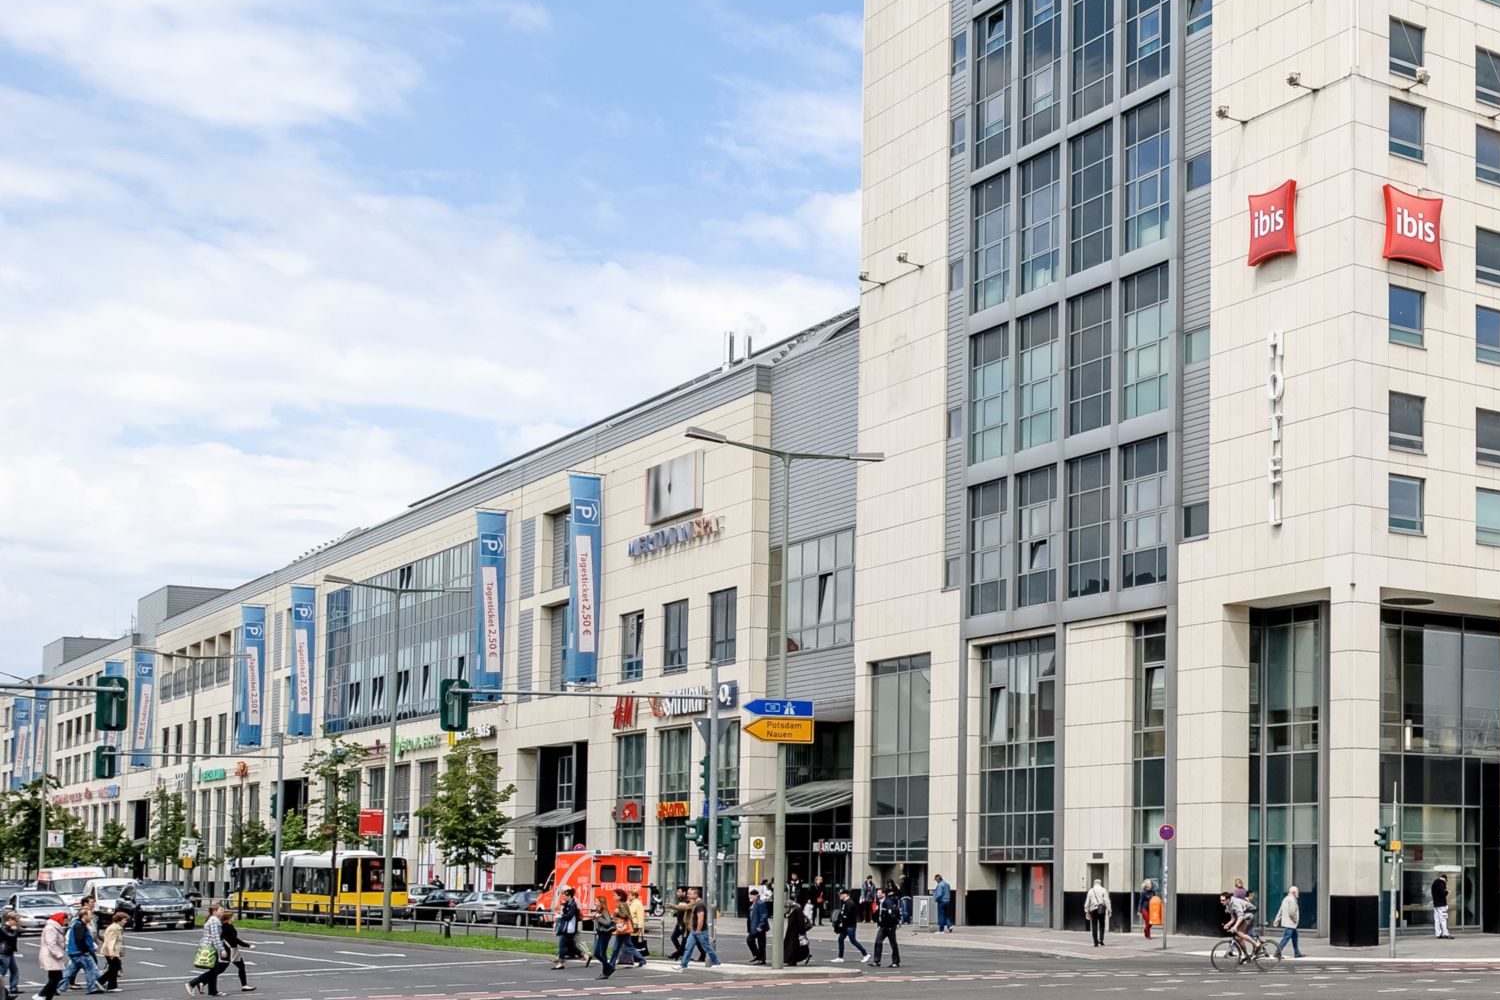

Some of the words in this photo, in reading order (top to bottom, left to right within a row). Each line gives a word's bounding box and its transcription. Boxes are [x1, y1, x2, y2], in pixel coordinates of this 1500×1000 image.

[1254, 205, 1284, 238] ibis
[1396, 207, 1436, 243] ibis
[1267, 329, 1284, 526] HOTEL
[579, 552, 590, 602] Tagesticket
[485, 582, 495, 628] Tagesticket
[582, 604, 592, 627] 2,50
[488, 629, 497, 650] 2,50
[661, 685, 707, 716] SATURN
[766, 721, 802, 729] Potsdam
[766, 730, 793, 738] Nauen
[601, 882, 641, 892] FEUERWEHR
